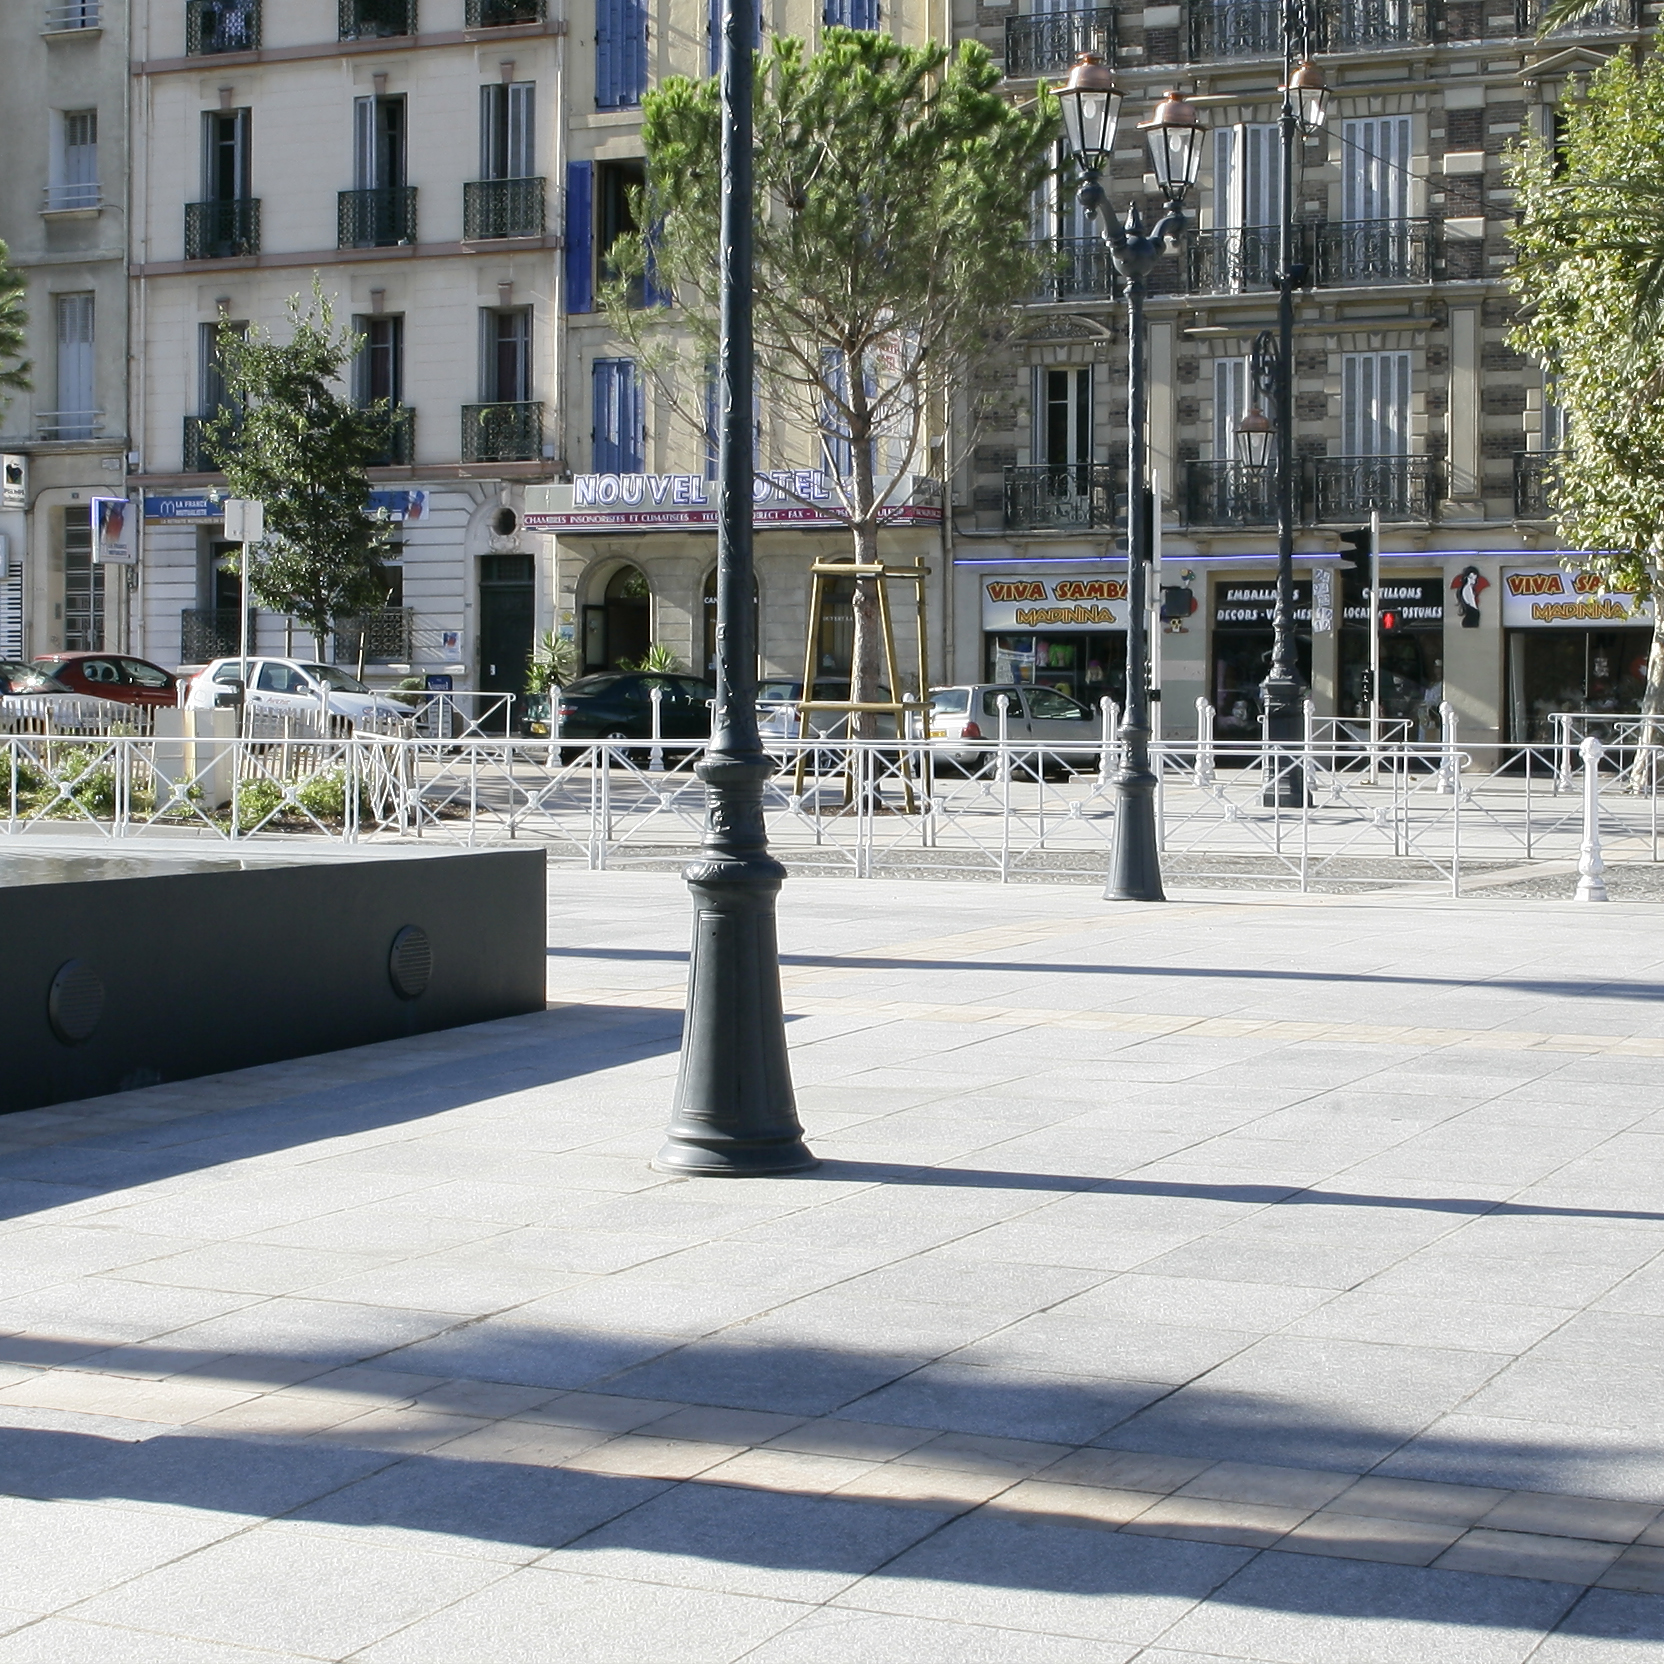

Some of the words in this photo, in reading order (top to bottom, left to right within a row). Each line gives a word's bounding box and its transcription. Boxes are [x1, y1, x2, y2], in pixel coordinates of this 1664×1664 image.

[573, 474, 710, 507] NOUVEL
[753, 470, 831, 504] OTEL
[788, 510, 804, 519] FAX
[1507, 572, 1565, 596] VIVA
[987, 580, 1047, 603] VIVA
[1226, 589, 1300, 601] EMBALLAS
[1362, 587, 1423, 599] CTILLONS
[1217, 609, 1258, 621] DECORS
